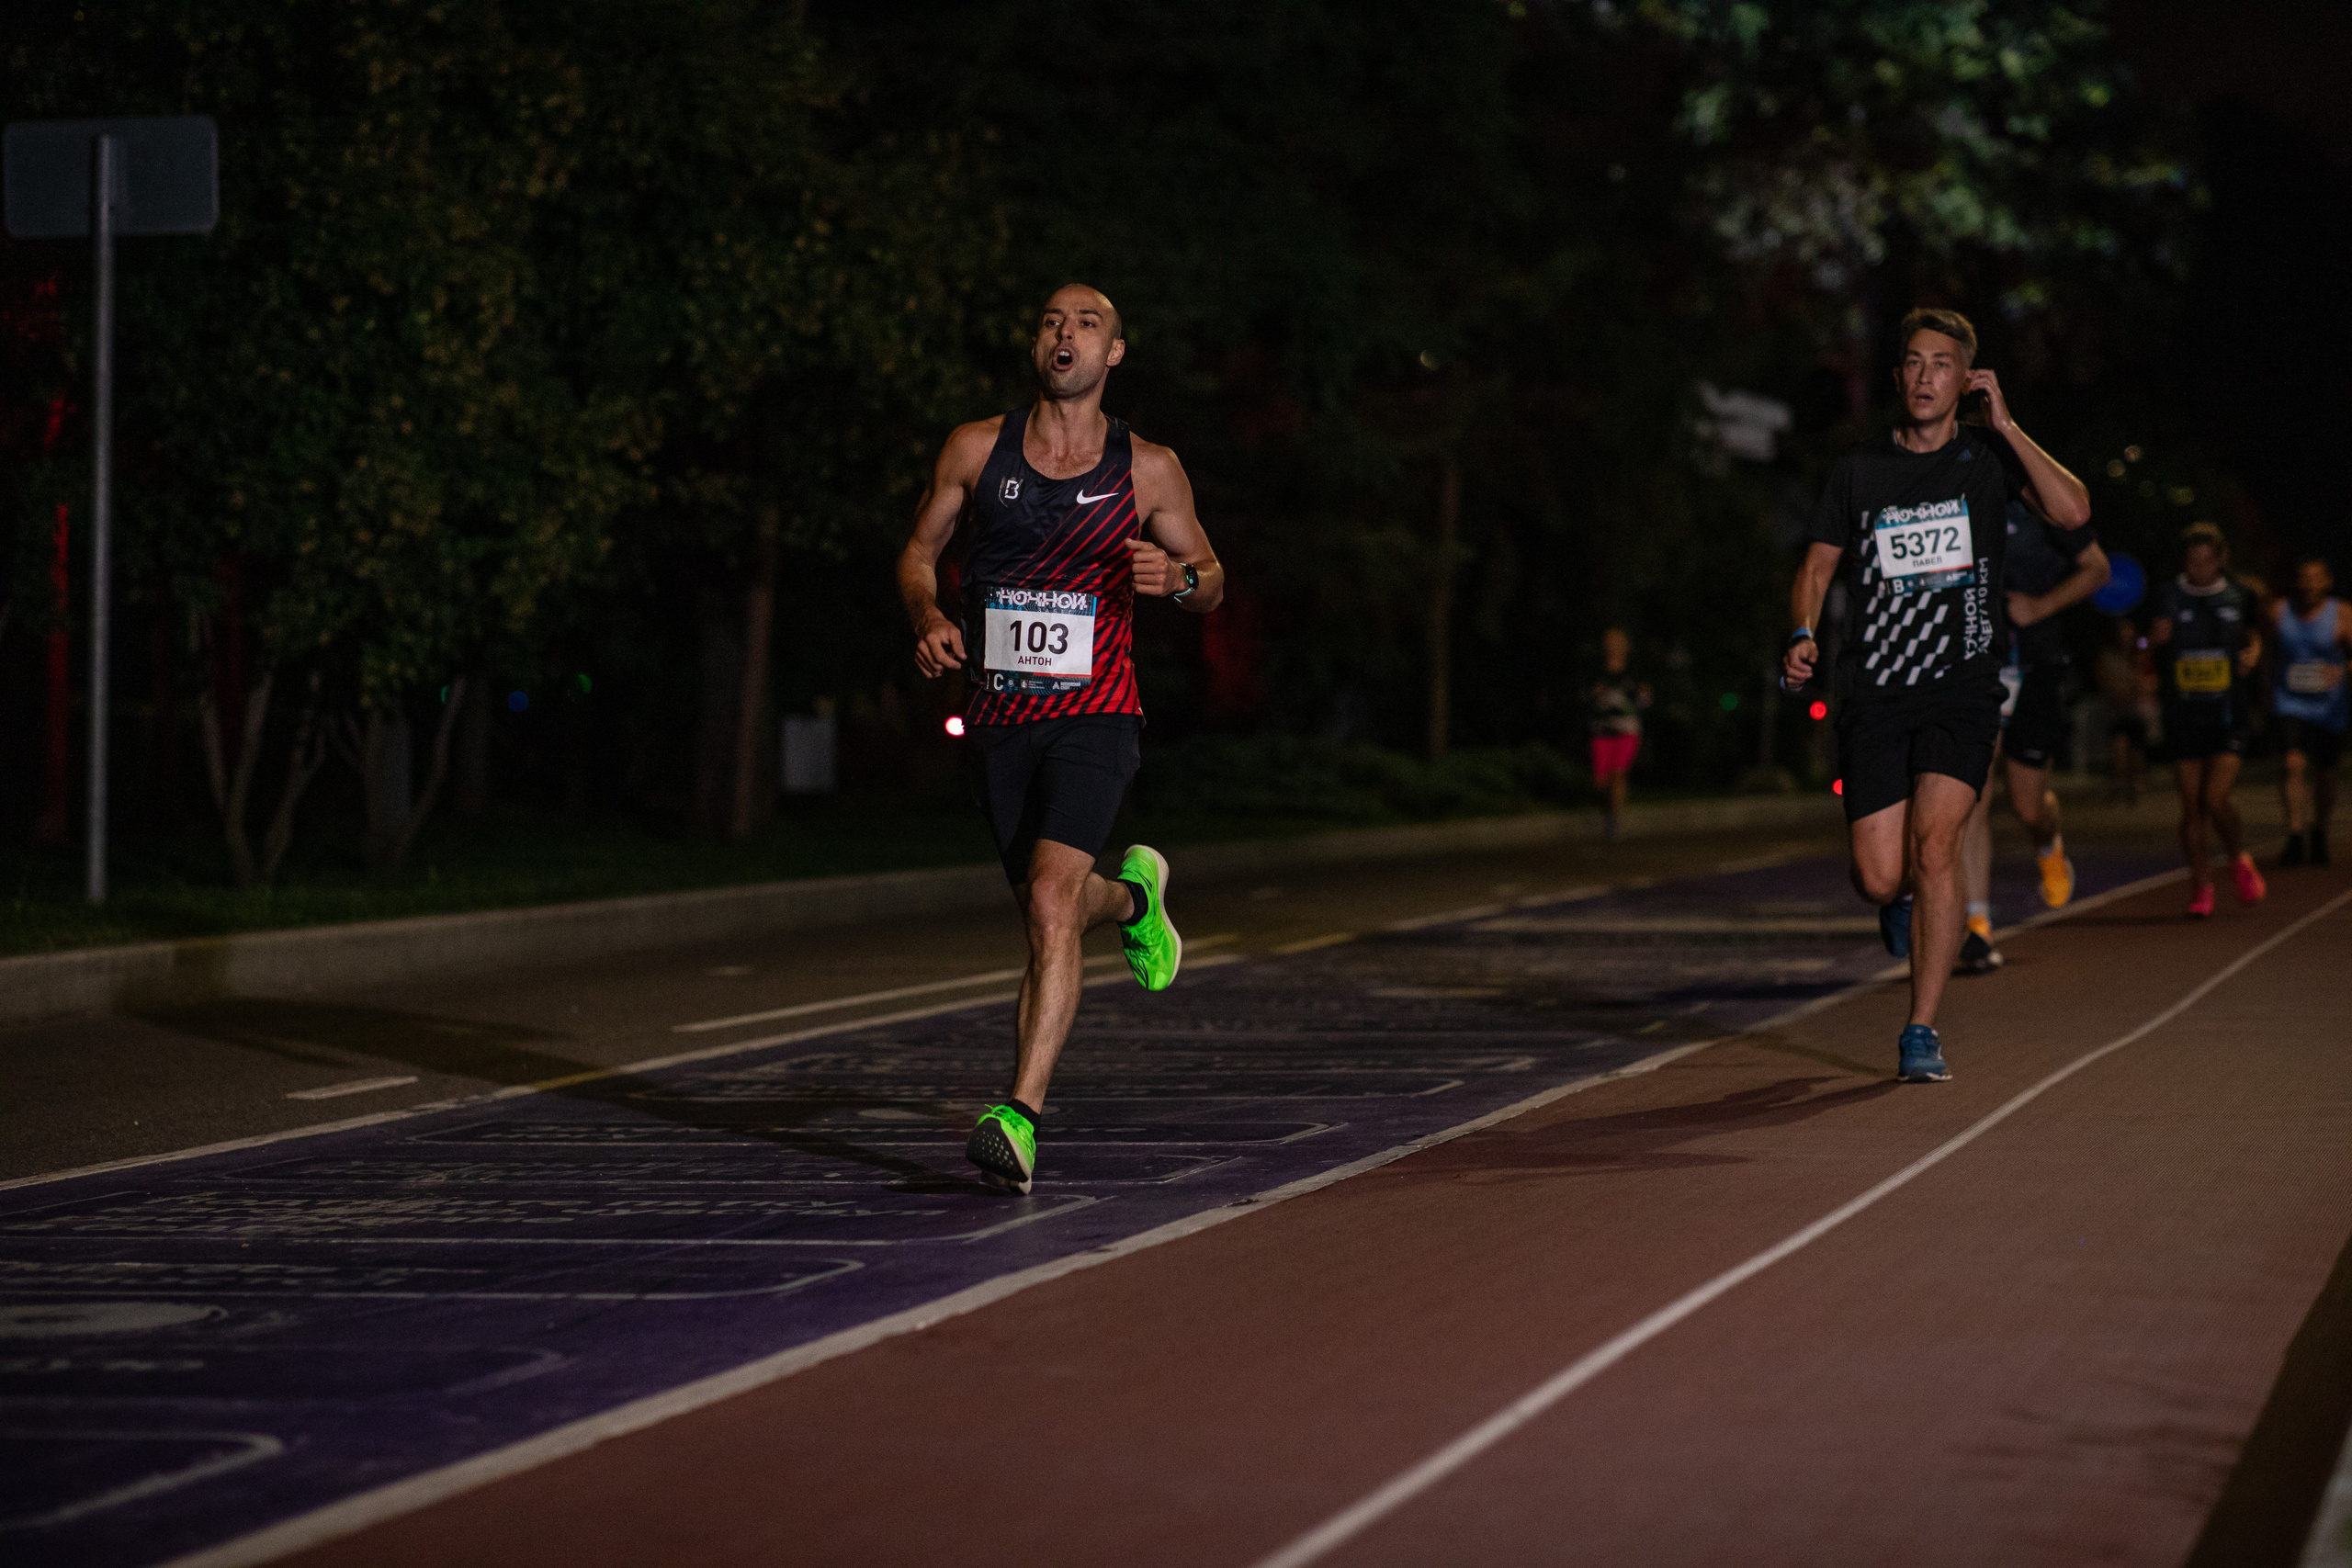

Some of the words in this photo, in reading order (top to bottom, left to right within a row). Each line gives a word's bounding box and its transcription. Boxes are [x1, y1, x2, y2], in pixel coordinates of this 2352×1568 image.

[1889, 526, 1962, 559] 5372
[1912, 556, 1943, 568] ПАВЕЛ
[996, 588, 1088, 611] НОЧНОЙ
[1010, 619, 1069, 655] 103
[1017, 655, 1052, 666] АНТОН
